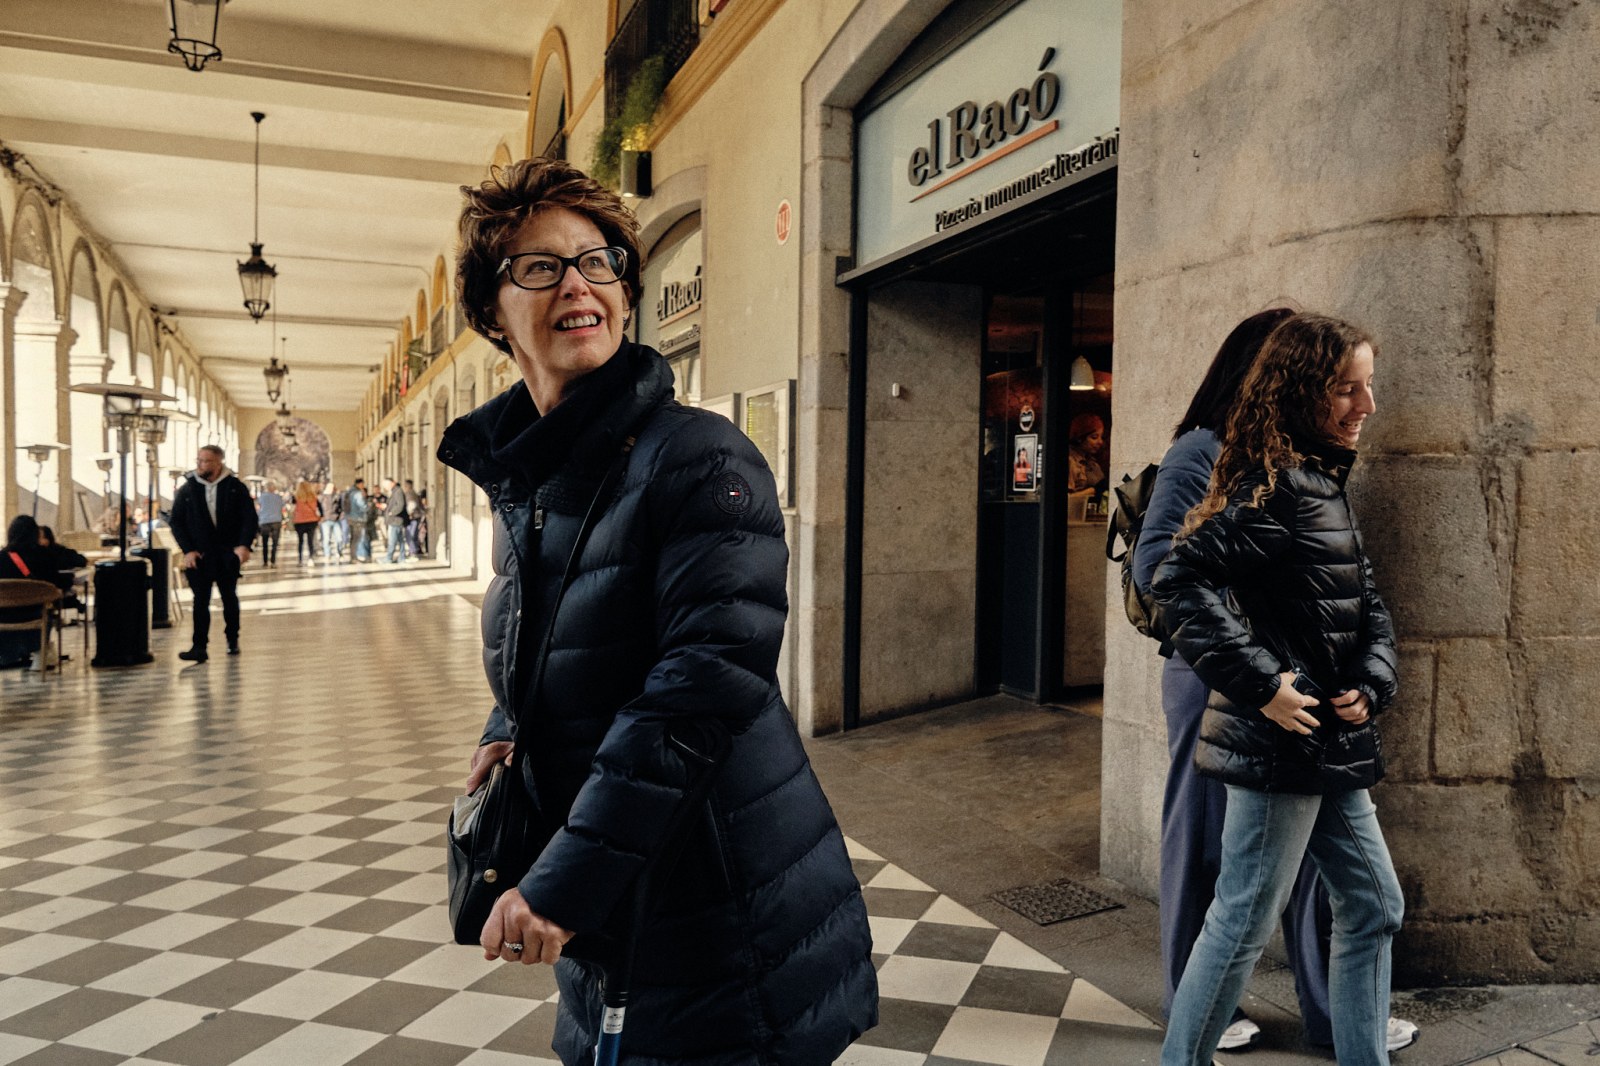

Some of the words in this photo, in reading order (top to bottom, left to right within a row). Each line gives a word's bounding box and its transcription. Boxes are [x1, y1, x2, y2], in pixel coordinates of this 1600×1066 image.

[908, 118, 942, 187] el
[945, 47, 1061, 170] Racó
[935, 198, 982, 232] Pizzeria
[668, 265, 702, 316] Racó
